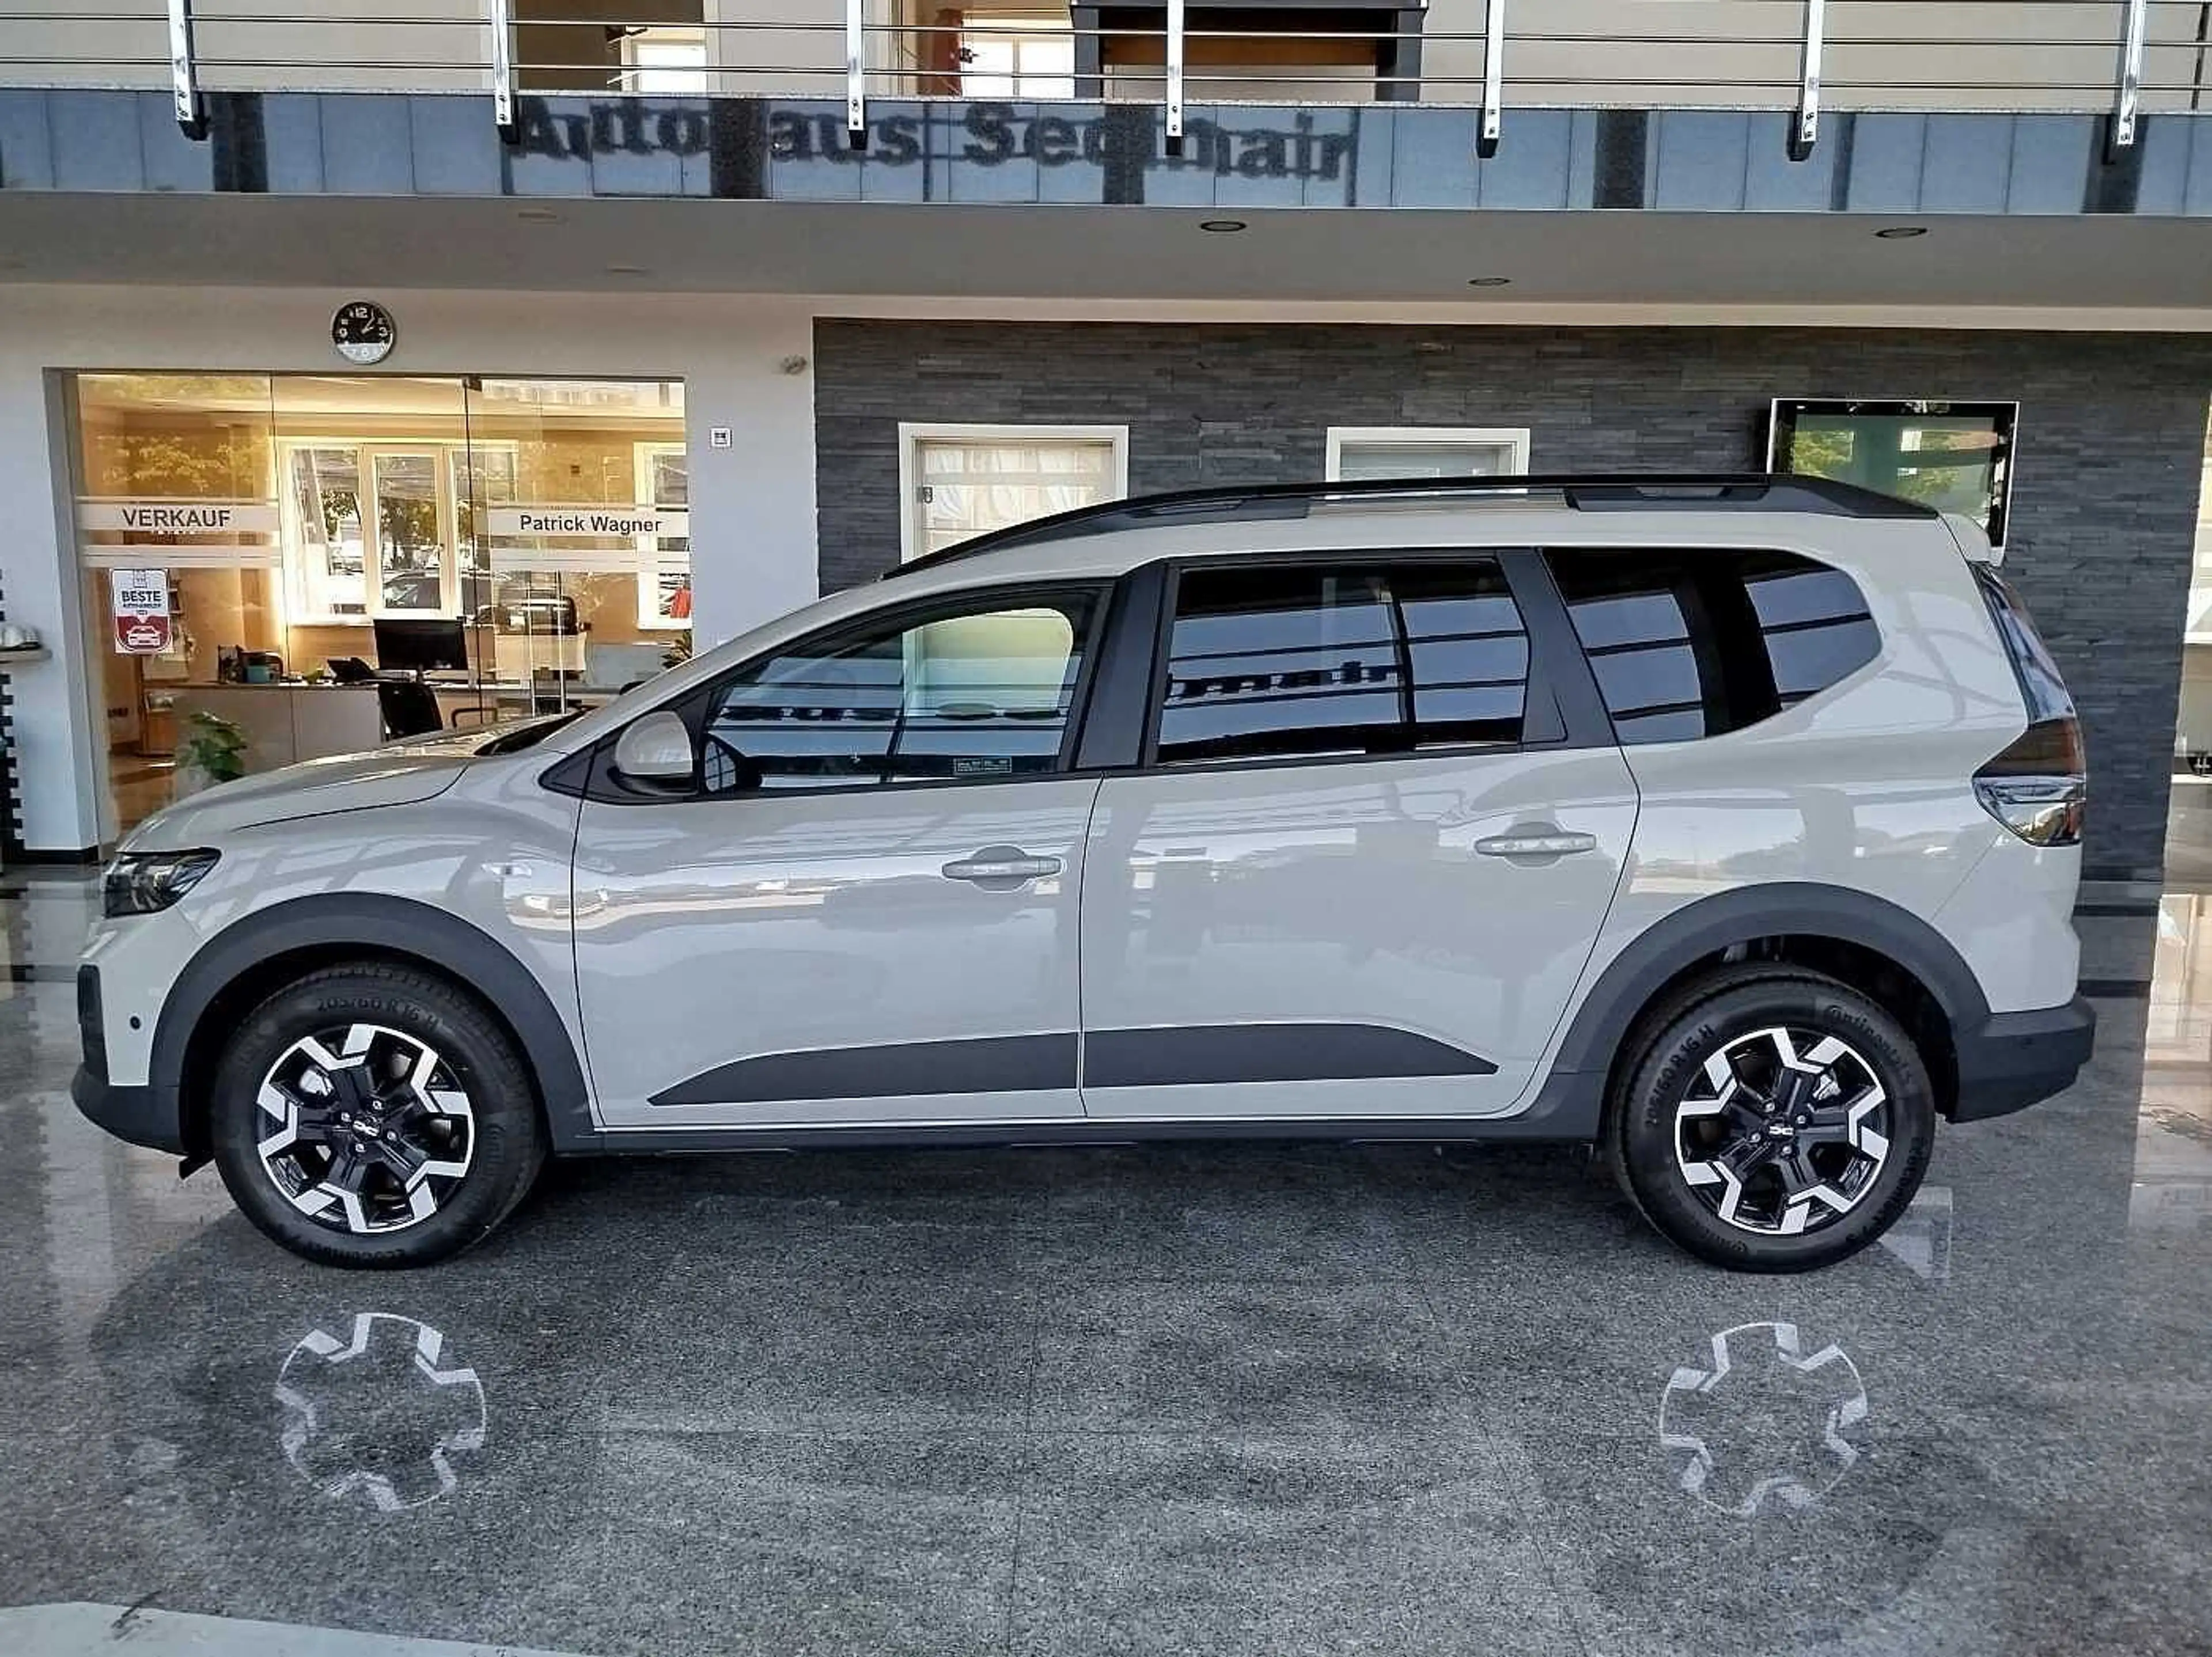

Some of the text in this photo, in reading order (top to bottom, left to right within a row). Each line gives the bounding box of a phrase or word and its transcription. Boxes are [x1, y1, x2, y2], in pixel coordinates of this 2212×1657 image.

[508, 95, 922, 166] Autoaus
[355, 307, 369, 318] 12
[122, 509, 230, 527] VERKAUF
[520, 515, 662, 535] Patrick Wagner
[122, 590, 162, 602] BESTE
